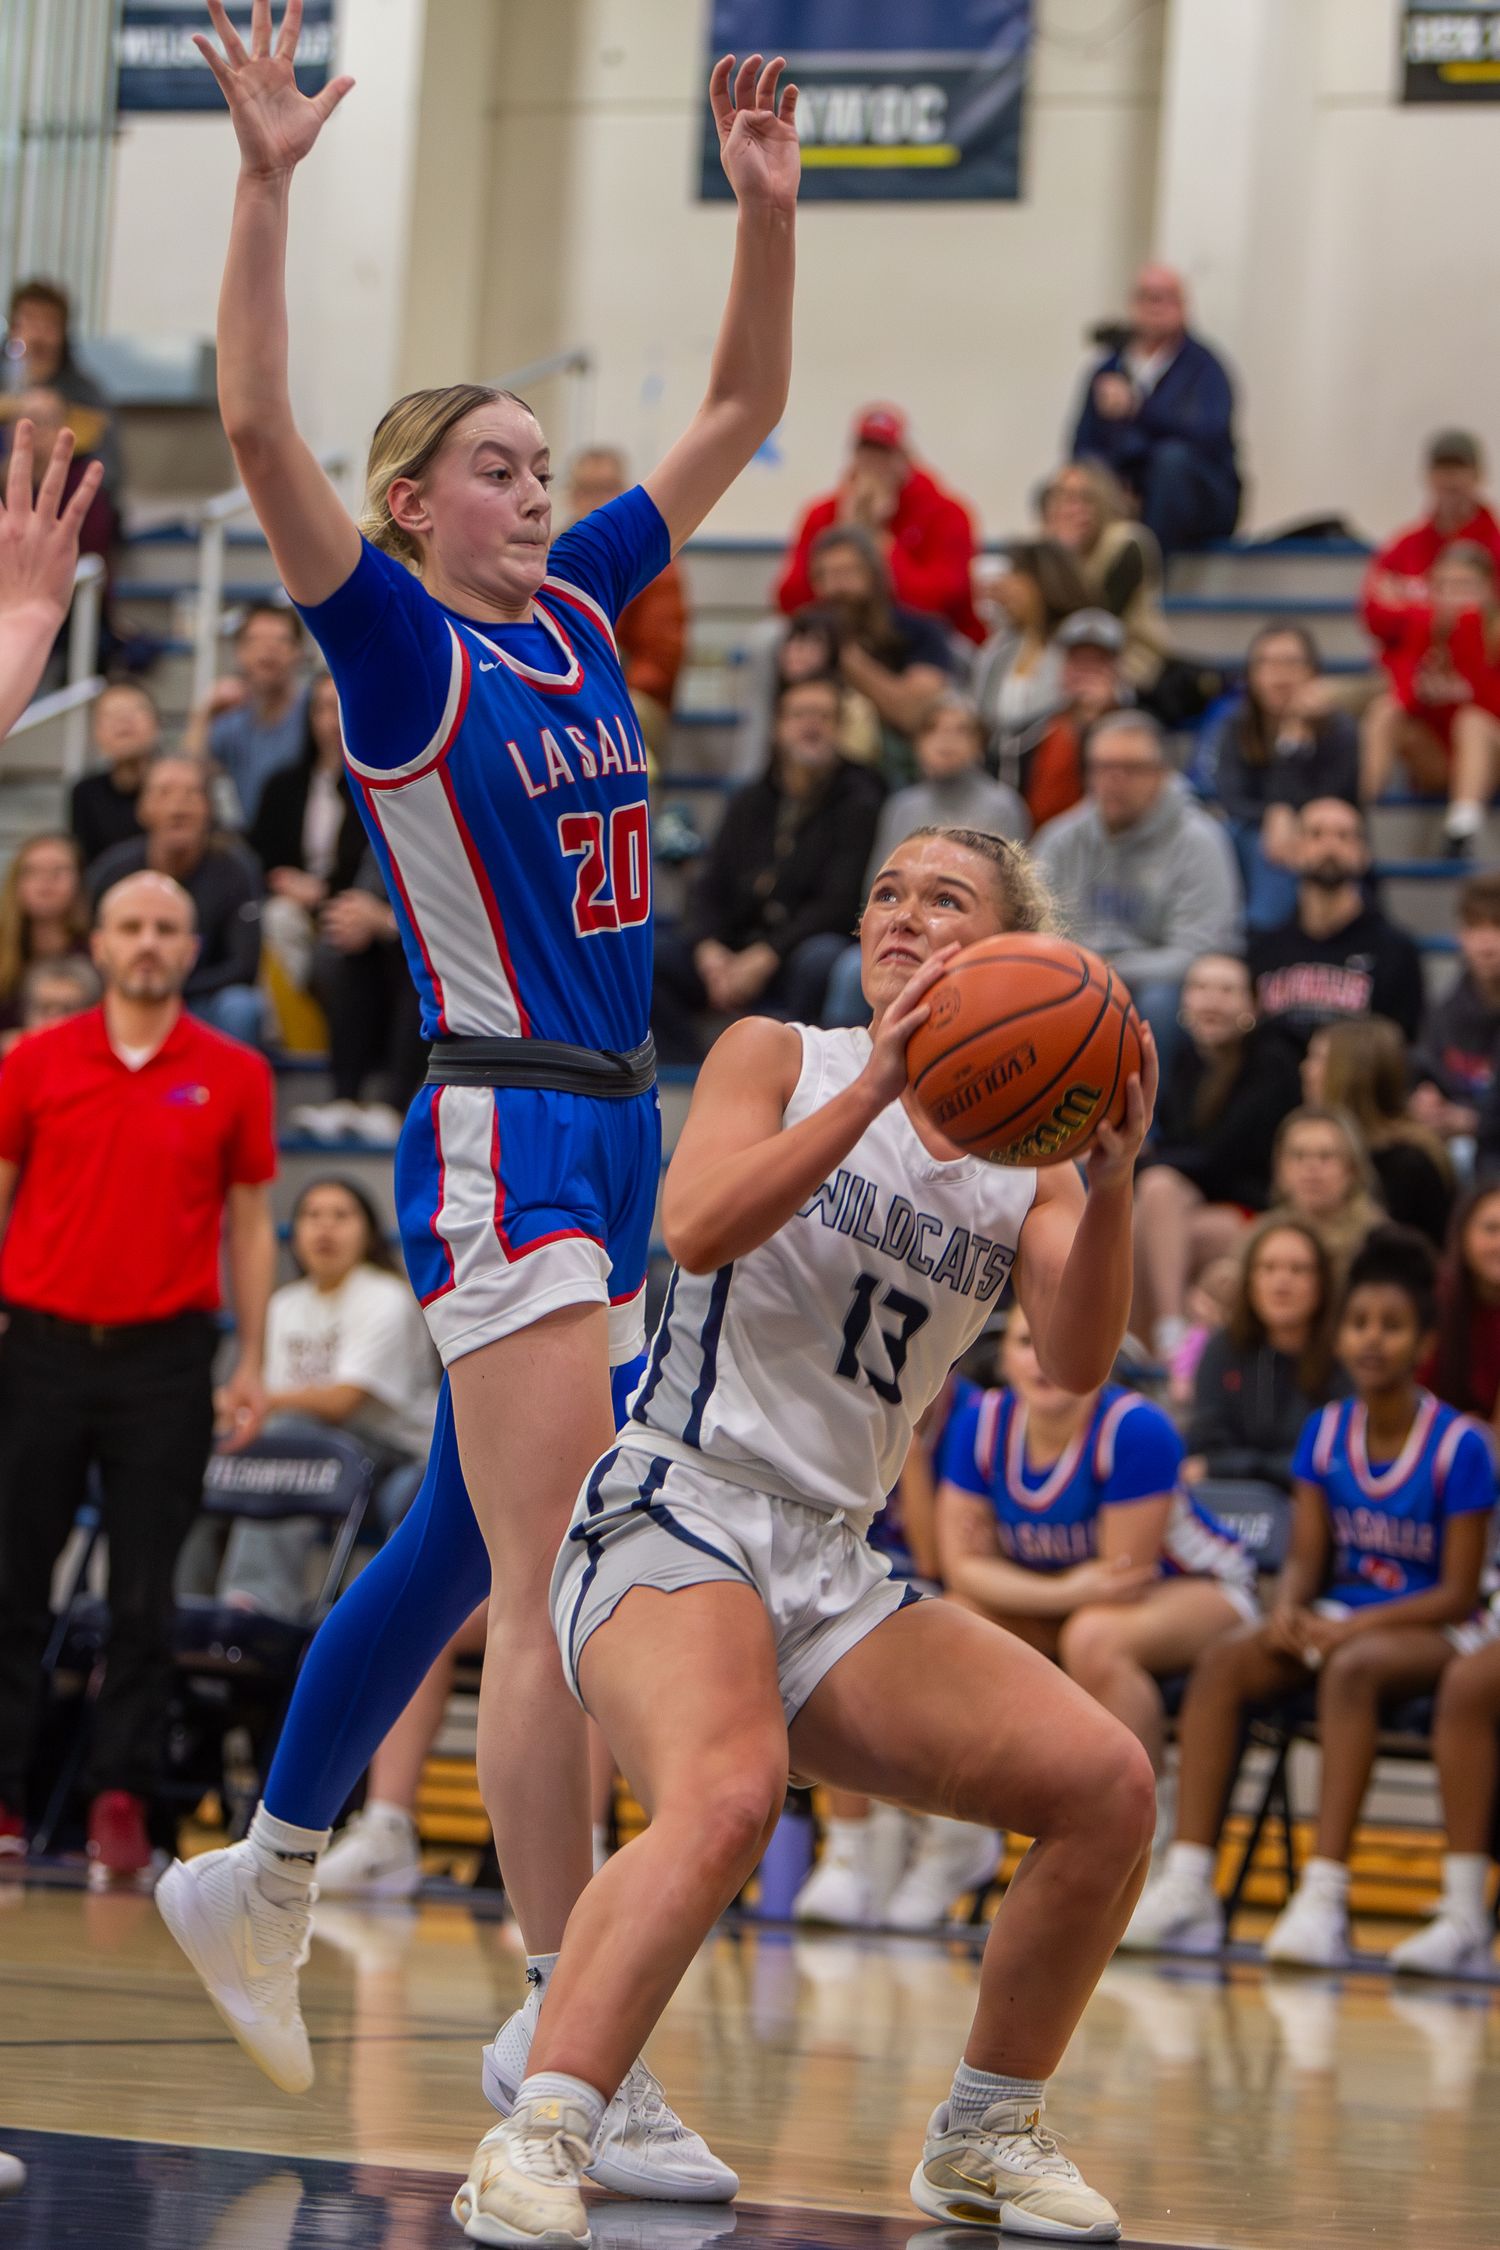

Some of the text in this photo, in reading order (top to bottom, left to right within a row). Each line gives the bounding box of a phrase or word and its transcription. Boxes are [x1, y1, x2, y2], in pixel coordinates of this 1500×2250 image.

[557, 799, 650, 939] 20
[796, 1168, 1016, 1302] WILDCATS
[834, 1271, 932, 1405] 13
